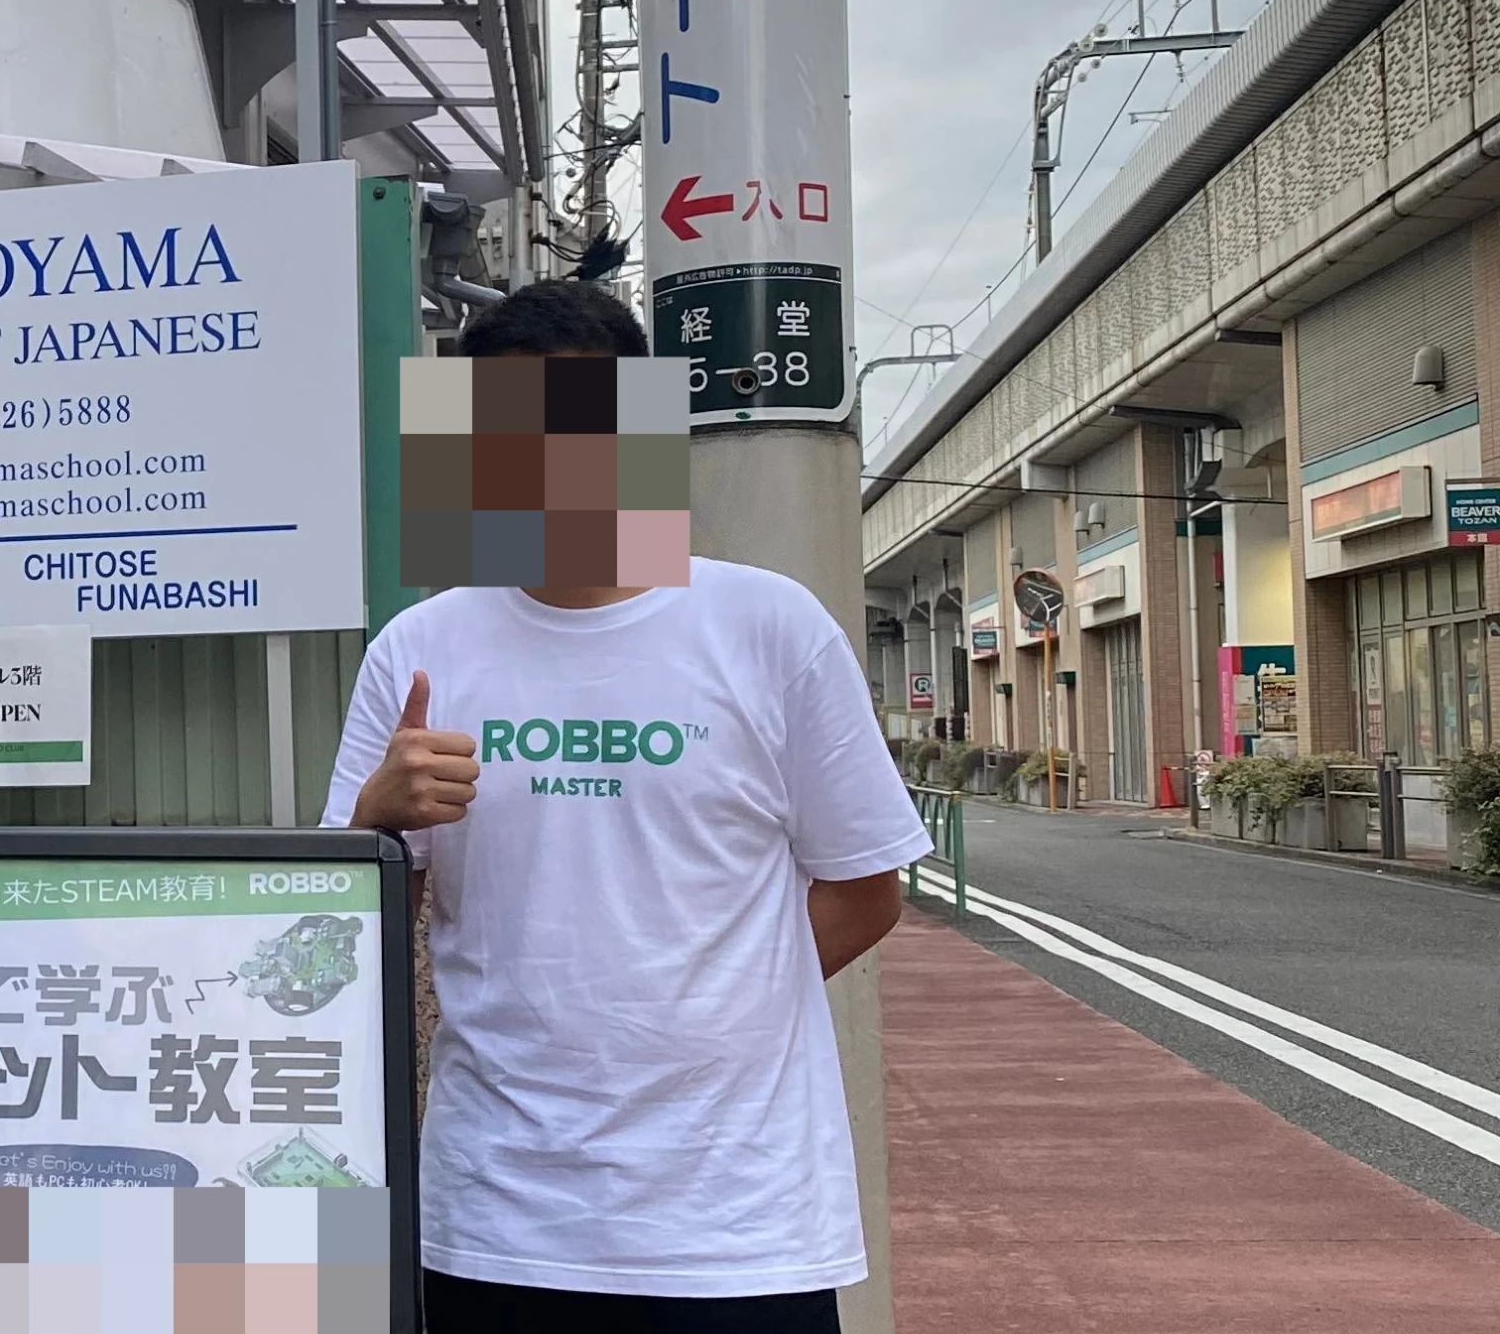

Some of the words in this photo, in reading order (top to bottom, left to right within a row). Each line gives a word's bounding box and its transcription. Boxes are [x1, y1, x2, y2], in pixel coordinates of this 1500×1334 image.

[742, 180, 830, 223] 入口
[13, 311, 261, 366] JAPANESE
[1451, 506, 1500, 517] BEAVER
[24, 550, 158, 583] CHITOSE
[78, 580, 259, 613] FUNABASHI
[532, 776, 622, 798] MASTER
[42, 1155, 93, 1175] Enjoy
[98, 1160, 136, 1176] with
